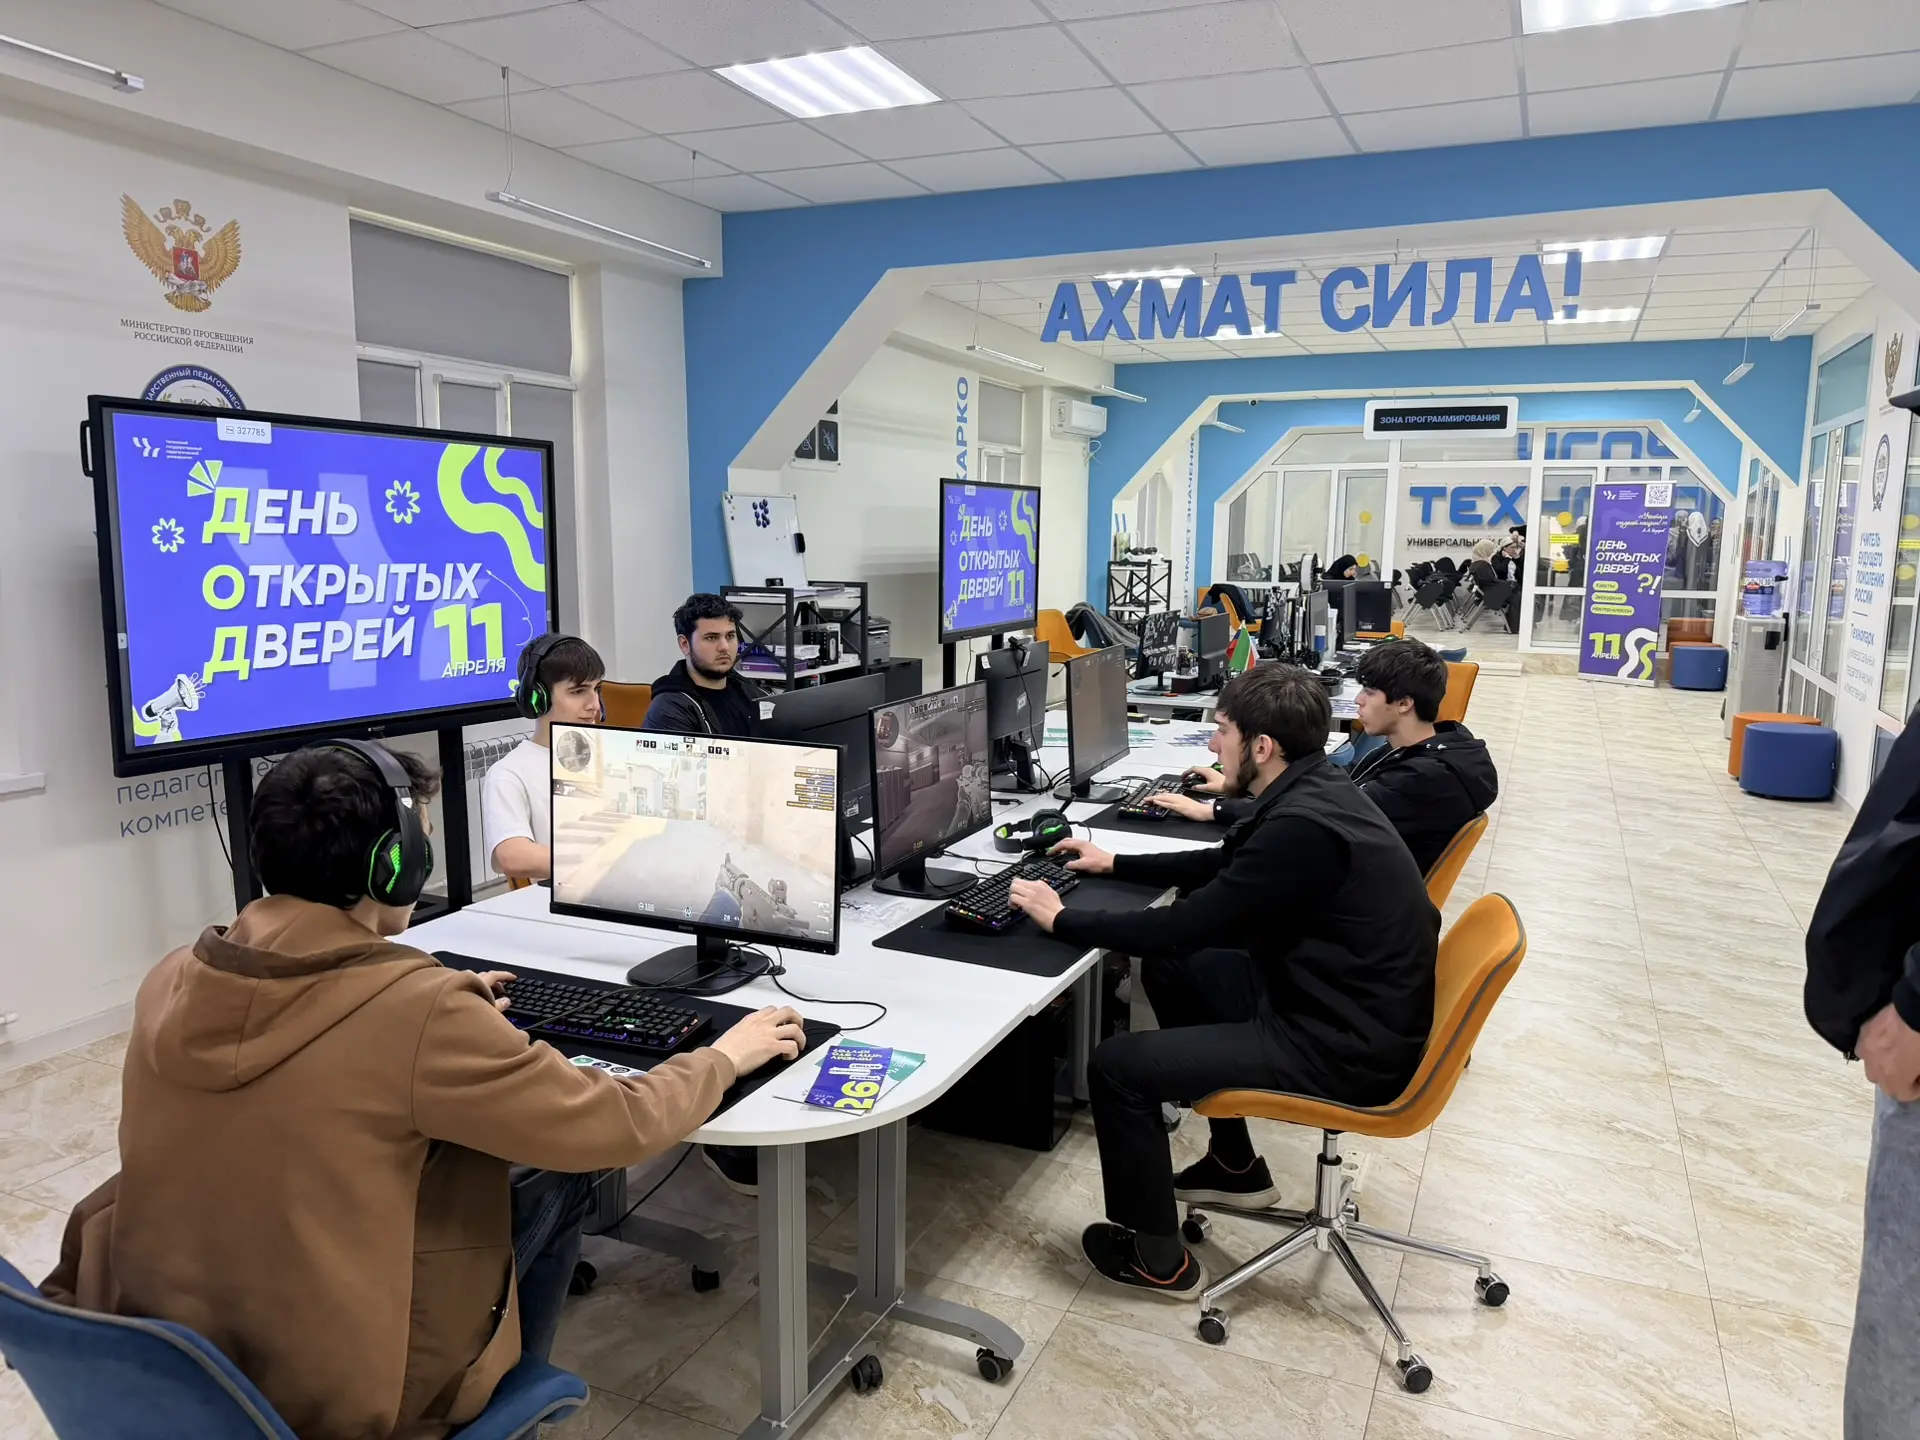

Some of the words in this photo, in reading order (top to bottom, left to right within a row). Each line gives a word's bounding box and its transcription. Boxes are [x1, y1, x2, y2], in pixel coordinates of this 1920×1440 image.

[1040, 270, 1297, 343] АХМАТ
[1320, 251, 1583, 333] СИЛА!
[120, 318, 192, 336] МИНИСТЕРСТВО
[193, 328, 254, 345] ПРОСВЕЩЕНИЯ
[193, 340, 244, 354] ФЕДЕРАЦИИ
[1380, 416, 1404, 425] ЗОНА
[1405, 413, 1501, 424] ПРОГРАММИРОВАНИЯ
[236, 426, 267, 437] 327785
[201, 486, 359, 544] ДЕНЬ
[959, 515, 993, 541] ДЕНЬ
[1859, 532, 1881, 547] УЧИТЕЛЬ
[1595, 540, 1628, 551] ДЕНЬ
[958, 549, 1021, 572] ОТКРЫТЫХ
[1593, 562, 1640, 575] ДВЕРЕЙ
[1595, 552, 1661, 564] ОТКРЫТЫХ
[1857, 550, 1883, 568] БУДУЩЕГО
[202, 562, 483, 611] ОТКРЫТЫХ
[957, 573, 1004, 605] ДВЕРЕЙ
[1007, 569, 1025, 601] 11
[1855, 569, 1885, 588] ПОКОЛЕНИЯ
[1854, 587, 1873, 604] РОССИИ
[202, 603, 416, 684] ДВЕРЕЙ
[433, 602, 505, 662] 11
[1588, 631, 1621, 656] 11
[1850, 623, 1875, 647] Технопарк
[1591, 651, 1621, 660] АПРЕЛЯ
[440, 656, 507, 679] АПРЕЛЯ
